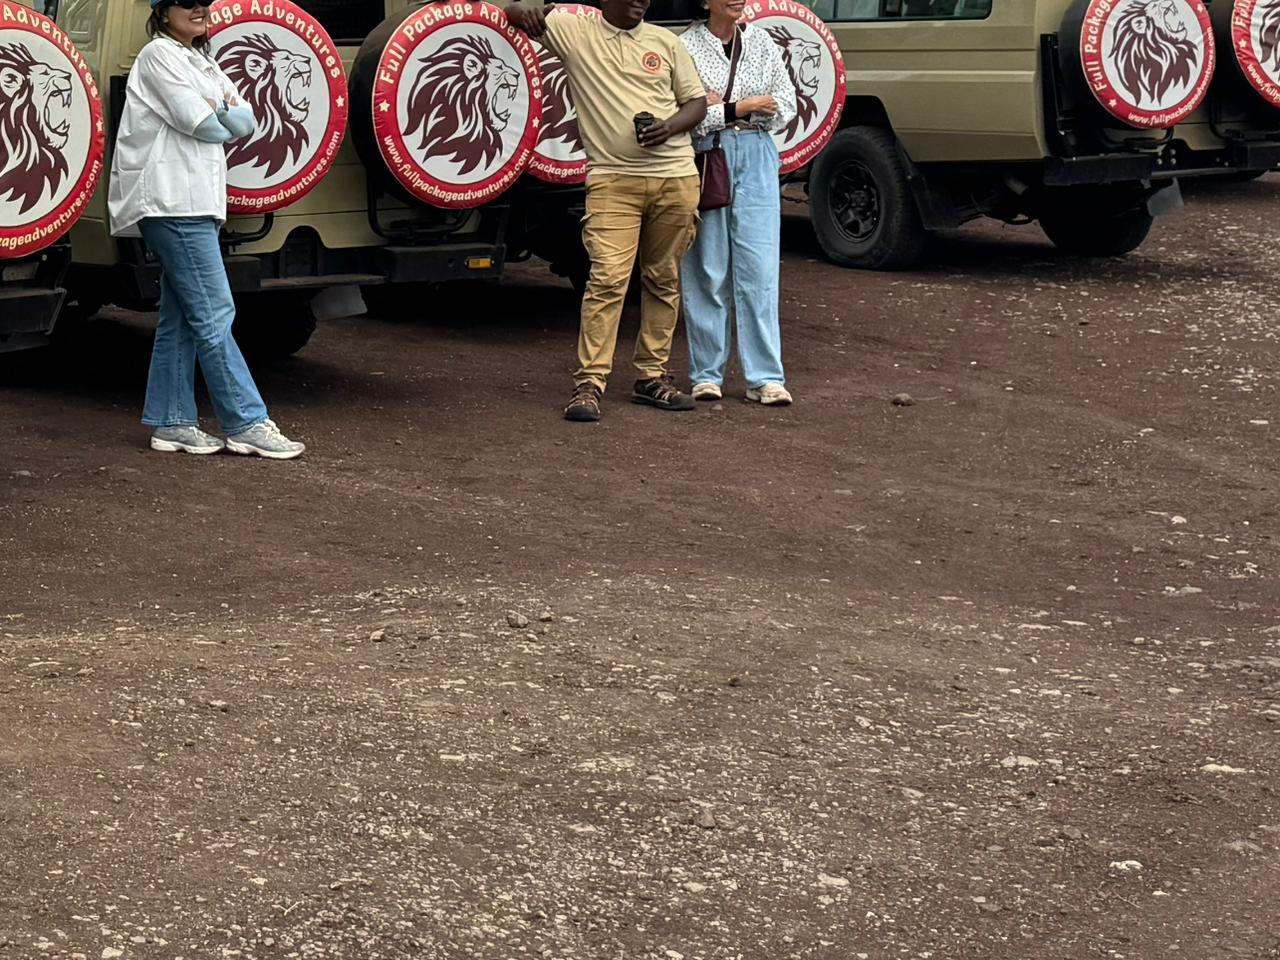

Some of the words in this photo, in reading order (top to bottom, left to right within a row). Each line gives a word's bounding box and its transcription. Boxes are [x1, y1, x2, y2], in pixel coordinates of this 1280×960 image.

[2, 4, 99, 98] Adventures
[379, 42, 407, 86] Full
[403, 2, 473, 42] Package
[479, 2, 542, 100] Adventures
[768, 0, 842, 60] Adventures
[1085, 61, 1107, 92] Full
[227, 131, 340, 208] ackageadventures.com
[384, 135, 530, 202] www.fullpackageadventures.com
